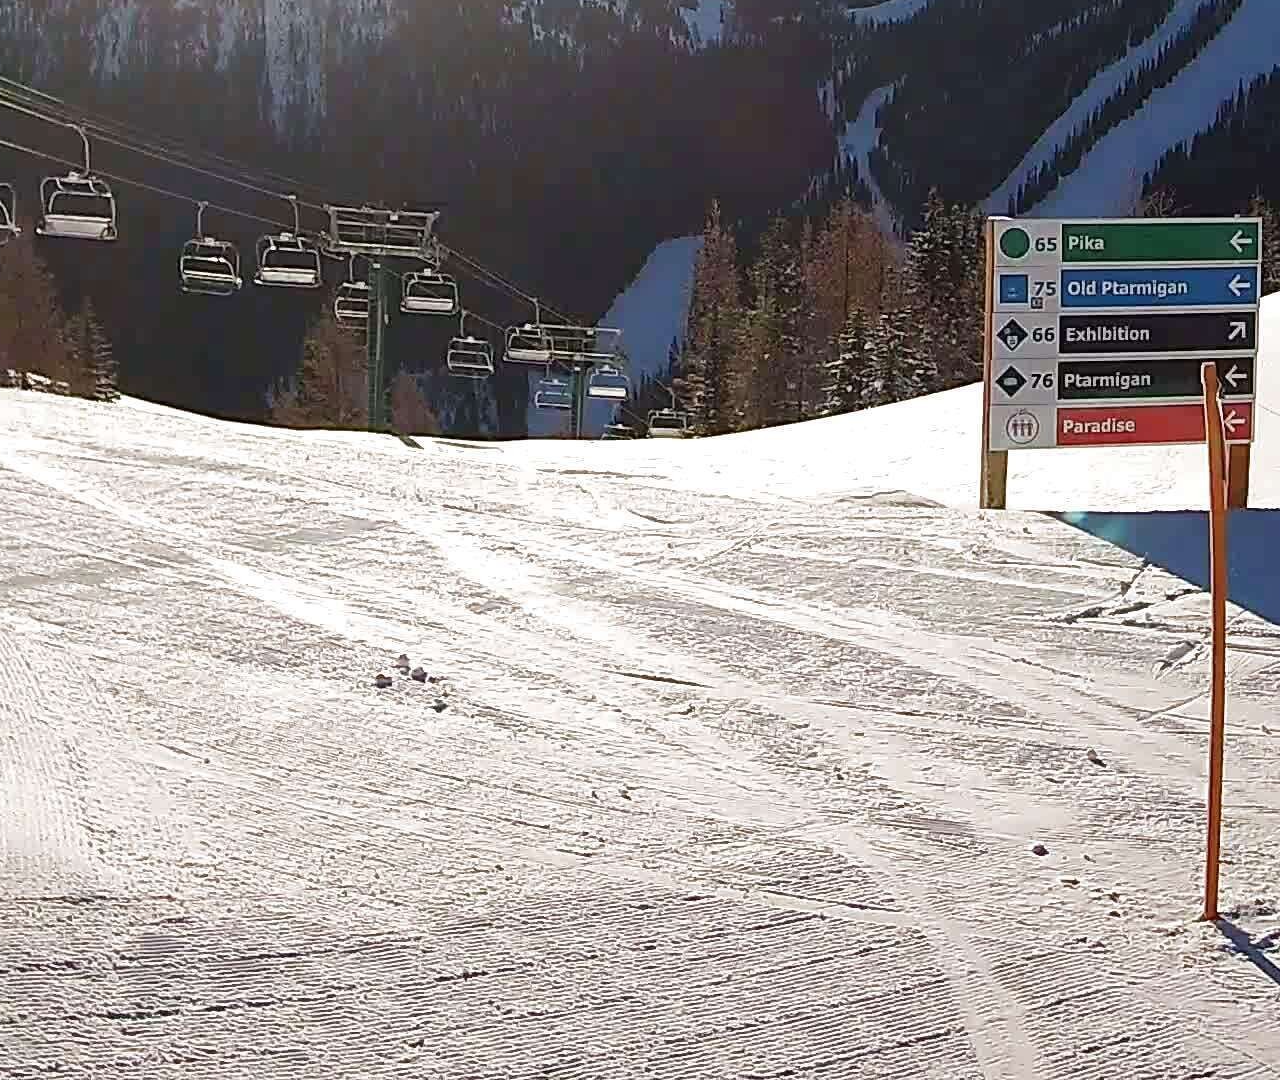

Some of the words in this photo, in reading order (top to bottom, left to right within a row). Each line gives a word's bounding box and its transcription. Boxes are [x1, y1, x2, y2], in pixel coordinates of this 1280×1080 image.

[1034, 237, 1057, 251] 65
[1068, 235, 1105, 251] Pika
[1034, 282, 1057, 296] 75
[1067, 280, 1097, 296] Old
[1102, 279, 1188, 298] Ptarmigan
[1032, 327, 1056, 342] 66
[1066, 326, 1151, 342] Exhibition
[1031, 373, 1054, 388] 76
[1064, 372, 1151, 391] Ptarmigan
[1063, 417, 1136, 434] Paradise
